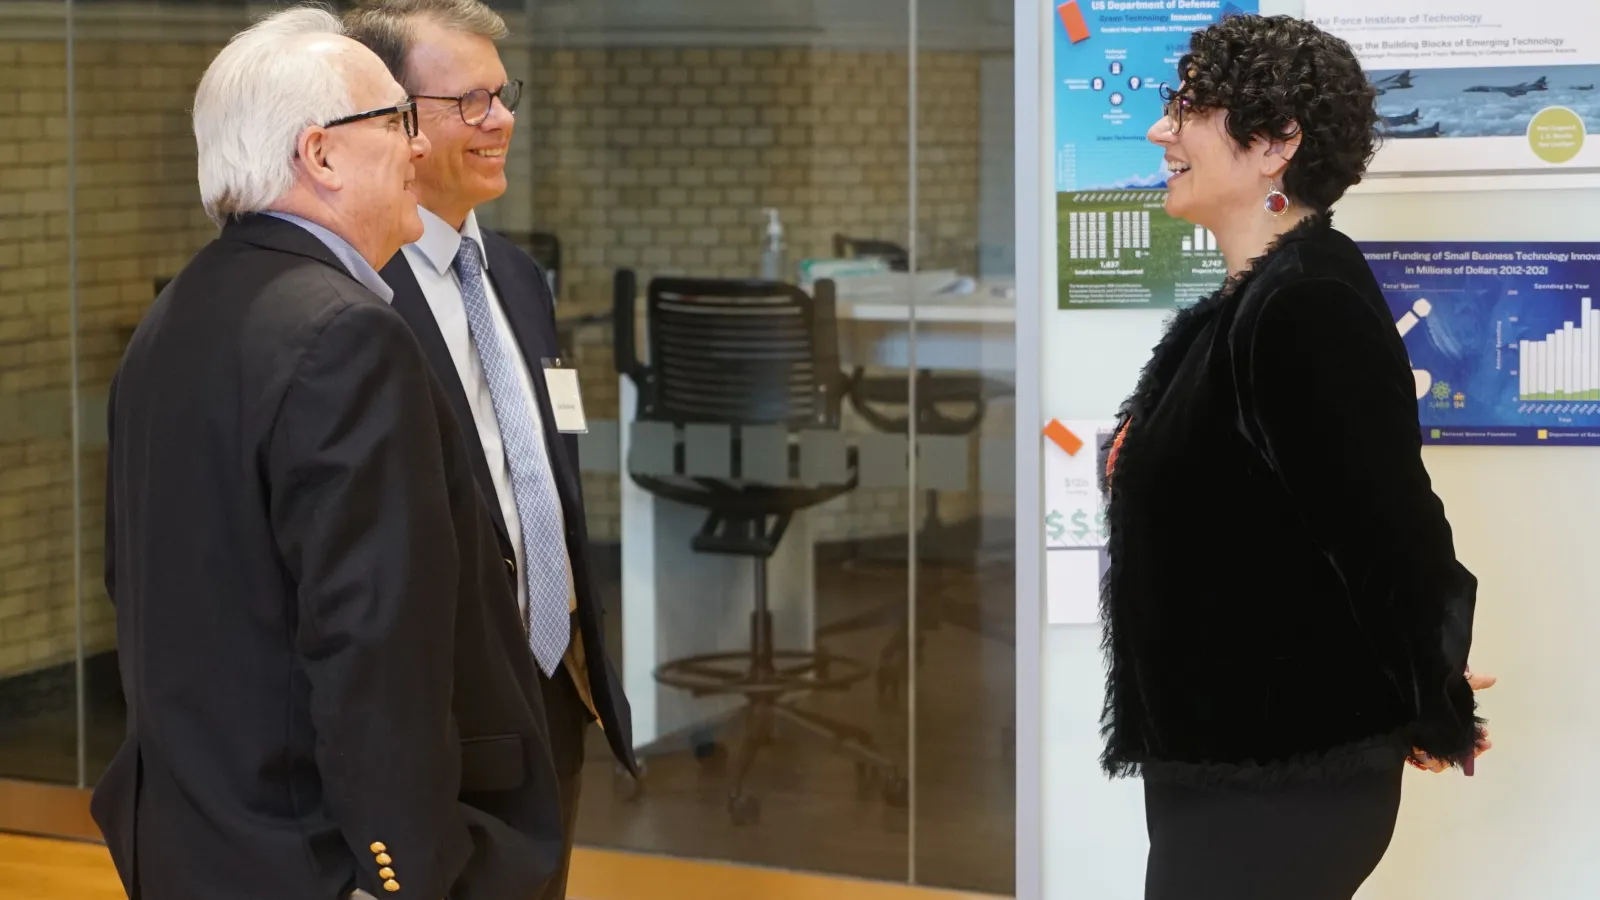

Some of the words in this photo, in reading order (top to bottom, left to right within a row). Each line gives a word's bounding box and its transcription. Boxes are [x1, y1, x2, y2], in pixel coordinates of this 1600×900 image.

[1091, 1, 1105, 10] US
[1107, 0, 1164, 11] Department
[1166, 0, 1176, 9] of
[1178, 0, 1220, 9] Defense:
[1099, 14, 1122, 23] Green
[1124, 13, 1169, 23] Technology
[1170, 13, 1213, 21] Innovation
[1316, 17, 1337, 26] Air
[1340, 16, 1363, 26] Force
[1364, 15, 1407, 25] Institute
[1409, 14, 1420, 24] of
[1423, 13, 1484, 25] Technology
[1365, 41, 1380, 50] the
[1382, 39, 1420, 51] Building
[1421, 39, 1452, 49] Blocks
[1454, 38, 1465, 48] of
[1466, 37, 1510, 49] Emerging
[1511, 36, 1565, 48] Technology
[1392, 250, 1431, 262] Funding
[1432, 251, 1443, 261] of
[1443, 250, 1470, 261] Small
[1471, 251, 1514, 261] Business
[1515, 250, 1569, 263] Technology
[1404, 265, 1415, 275] in
[1415, 265, 1453, 275] Millions
[1453, 265, 1464, 275] of
[1465, 265, 1498, 275] Dollars
[1499, 265, 1549, 275] 2012-2021
[1400, 282, 1420, 291] Spent
[1533, 283, 1564, 291] Spending
[1565, 283, 1574, 291] by
[1548, 431, 1579, 439] Department
